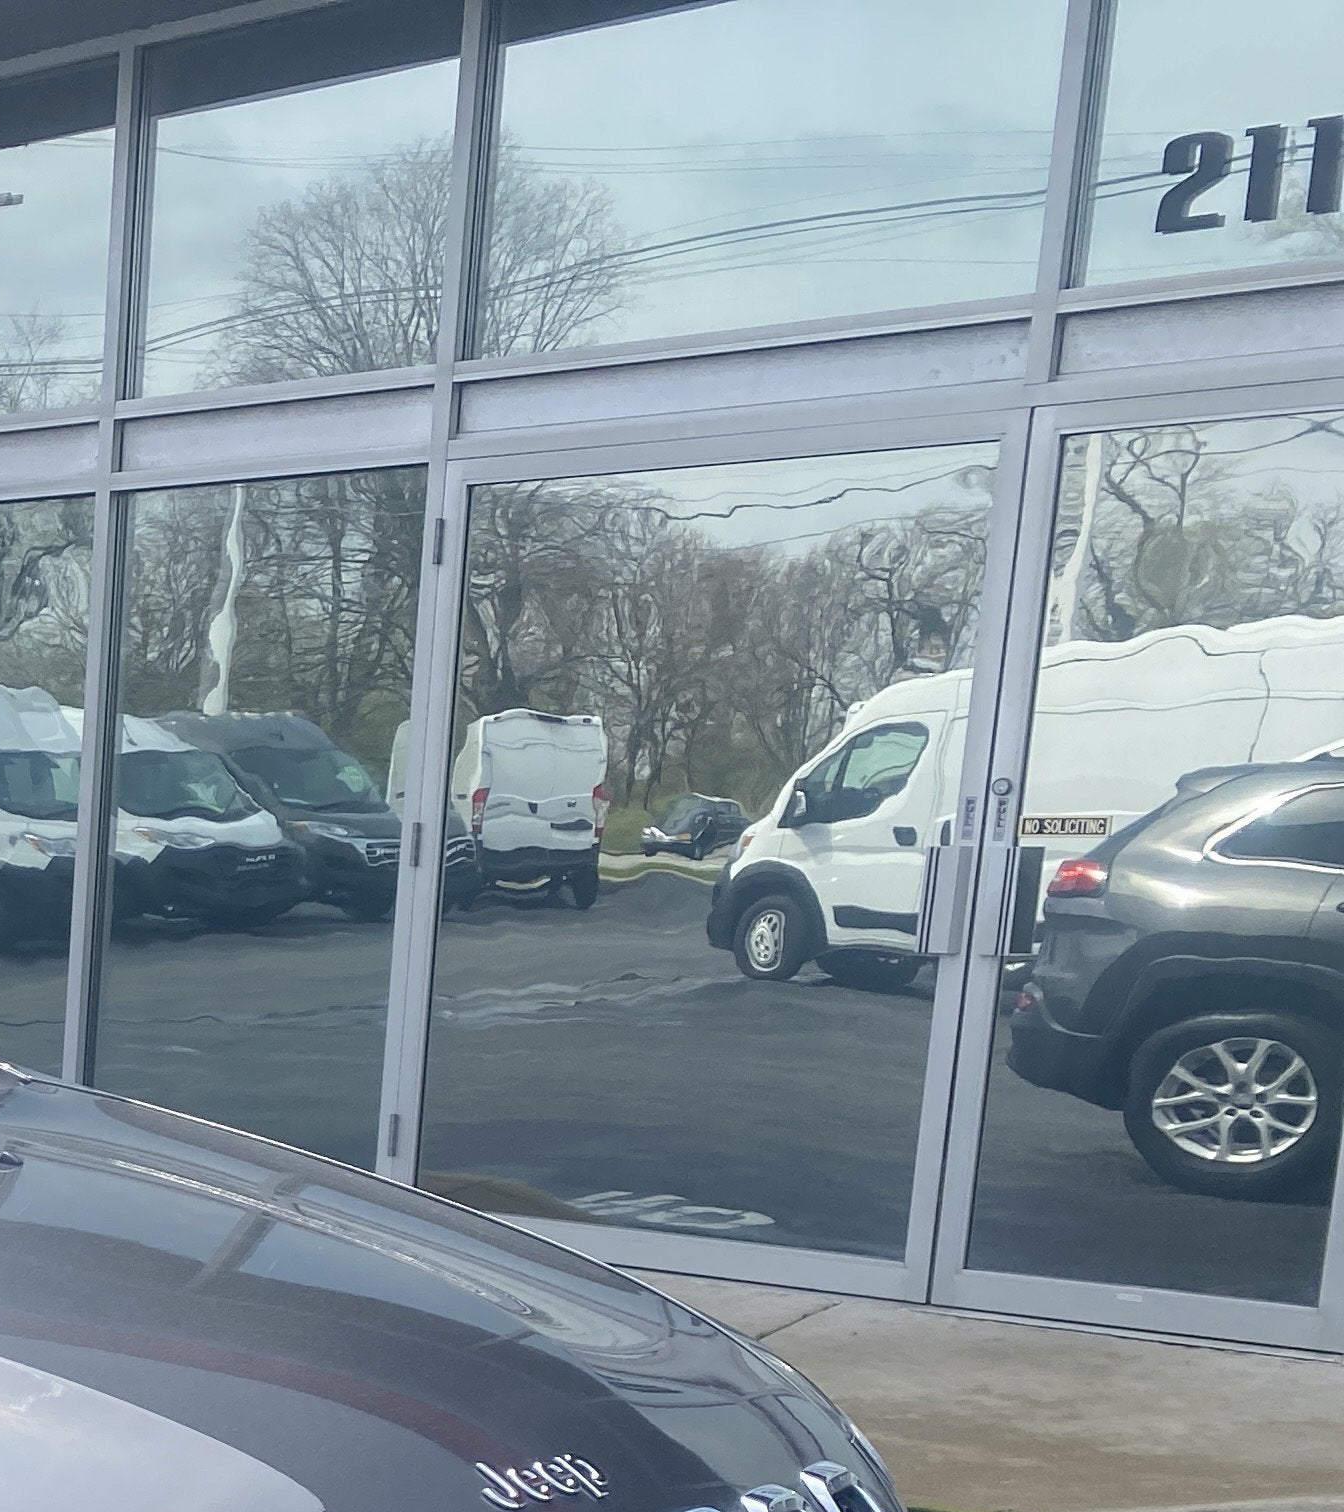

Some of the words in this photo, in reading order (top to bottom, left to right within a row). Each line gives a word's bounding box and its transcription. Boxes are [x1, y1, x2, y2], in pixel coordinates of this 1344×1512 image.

[1155, 115, 1344, 234] 211
[997, 800, 1008, 828] PULL
[1024, 819, 1040, 833] NO
[1043, 818, 1105, 834] SOLICITING
[475, 1453, 610, 1509] Jeep
